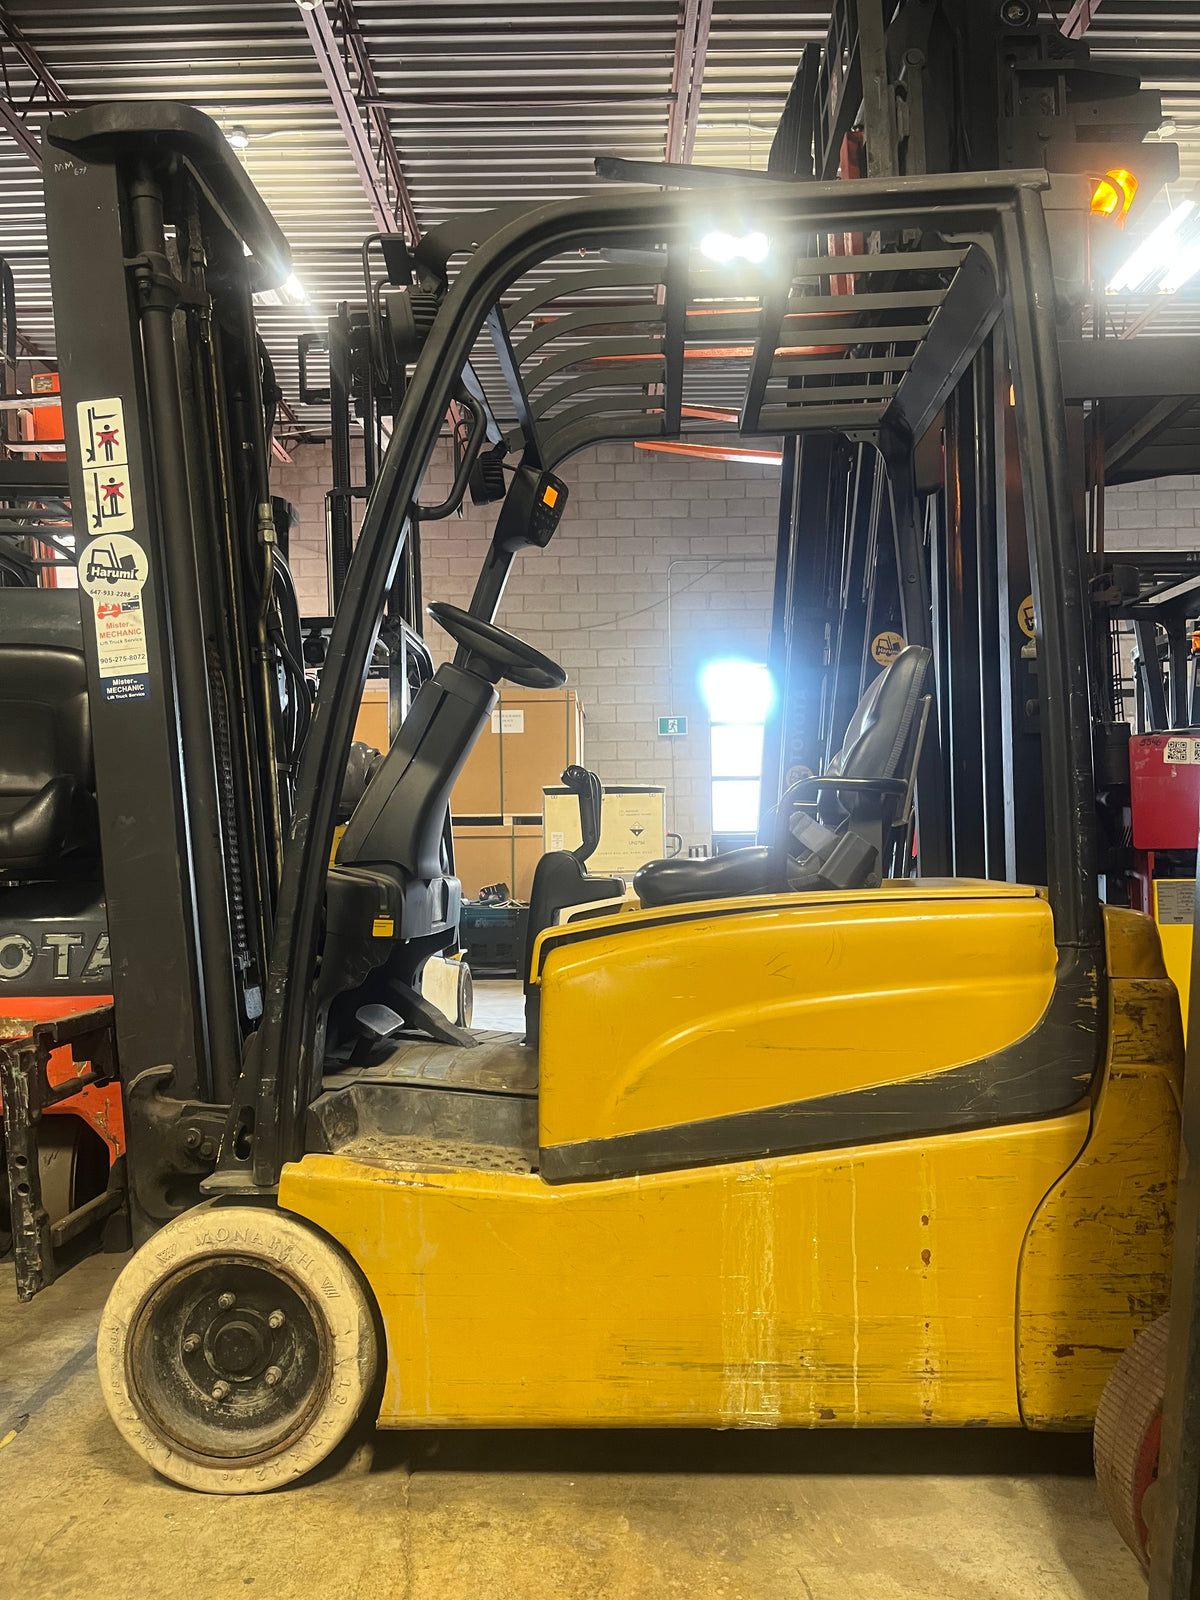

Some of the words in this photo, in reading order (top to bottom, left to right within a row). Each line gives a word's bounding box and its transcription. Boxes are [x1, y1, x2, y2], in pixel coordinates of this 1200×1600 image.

[91, 566, 135, 579] Harumi
[90, 589, 131, 598] 647-933-2288
[106, 621, 129, 630] Mister
[99, 628, 142, 639] MECHANIC
[100, 653, 146, 665] 905-275-8072
[112, 678, 133, 686] Mister
[106, 683, 145, 694] MECHANIC
[194, 1227, 317, 1271] MONARCH
